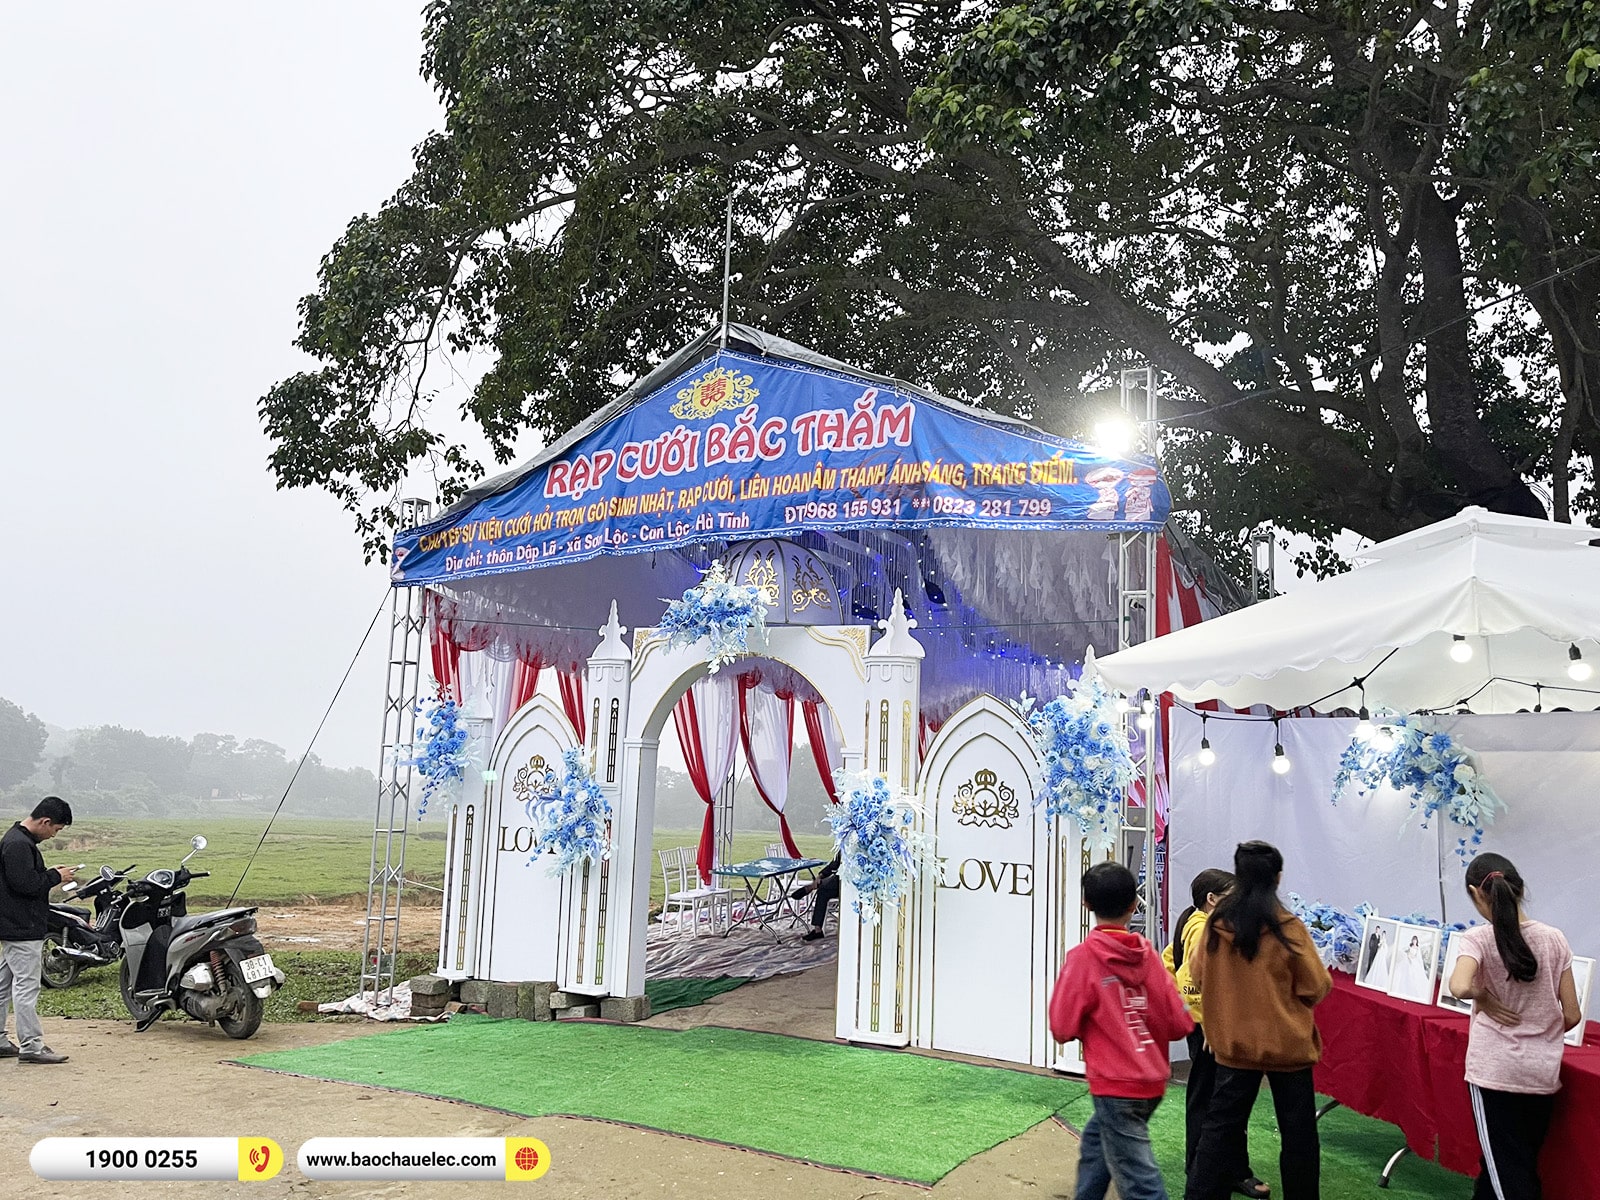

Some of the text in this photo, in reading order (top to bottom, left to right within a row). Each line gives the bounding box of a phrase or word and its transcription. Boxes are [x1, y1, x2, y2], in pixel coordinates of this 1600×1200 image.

[544, 390, 914, 499] RẠP CƯỚI BẮC THẮM
[478, 516, 504, 545] KIỆN
[505, 512, 532, 537] CƯỚI
[533, 504, 553, 532] HỎI
[556, 506, 587, 532] TRỌN
[588, 497, 608, 523] GÓI
[608, 496, 639, 517] SINH
[639, 487, 675, 518] NHẬT,
[677, 485, 702, 514] RẠP
[740, 473, 770, 500] LIÊN
[811, 461, 837, 490] ÂM
[840, 463, 887, 489] THANH
[888, 459, 923, 486] ÁNH
[972, 463, 1027, 486] TRANG
[842, 500, 868, 519] 155
[870, 498, 900, 516] 931
[933, 495, 976, 515] 0823
[979, 499, 1011, 517] 281
[1018, 499, 1051, 517] 799
[486, 548, 513, 566] thôn
[542, 540, 557, 557] Lã
[566, 537, 582, 553] xã
[604, 527, 629, 549] Lộc
[639, 524, 664, 542] Can
[667, 520, 690, 541] Lộc
[695, 513, 714, 531] Hà
[717, 511, 750, 529] Tĩnh
